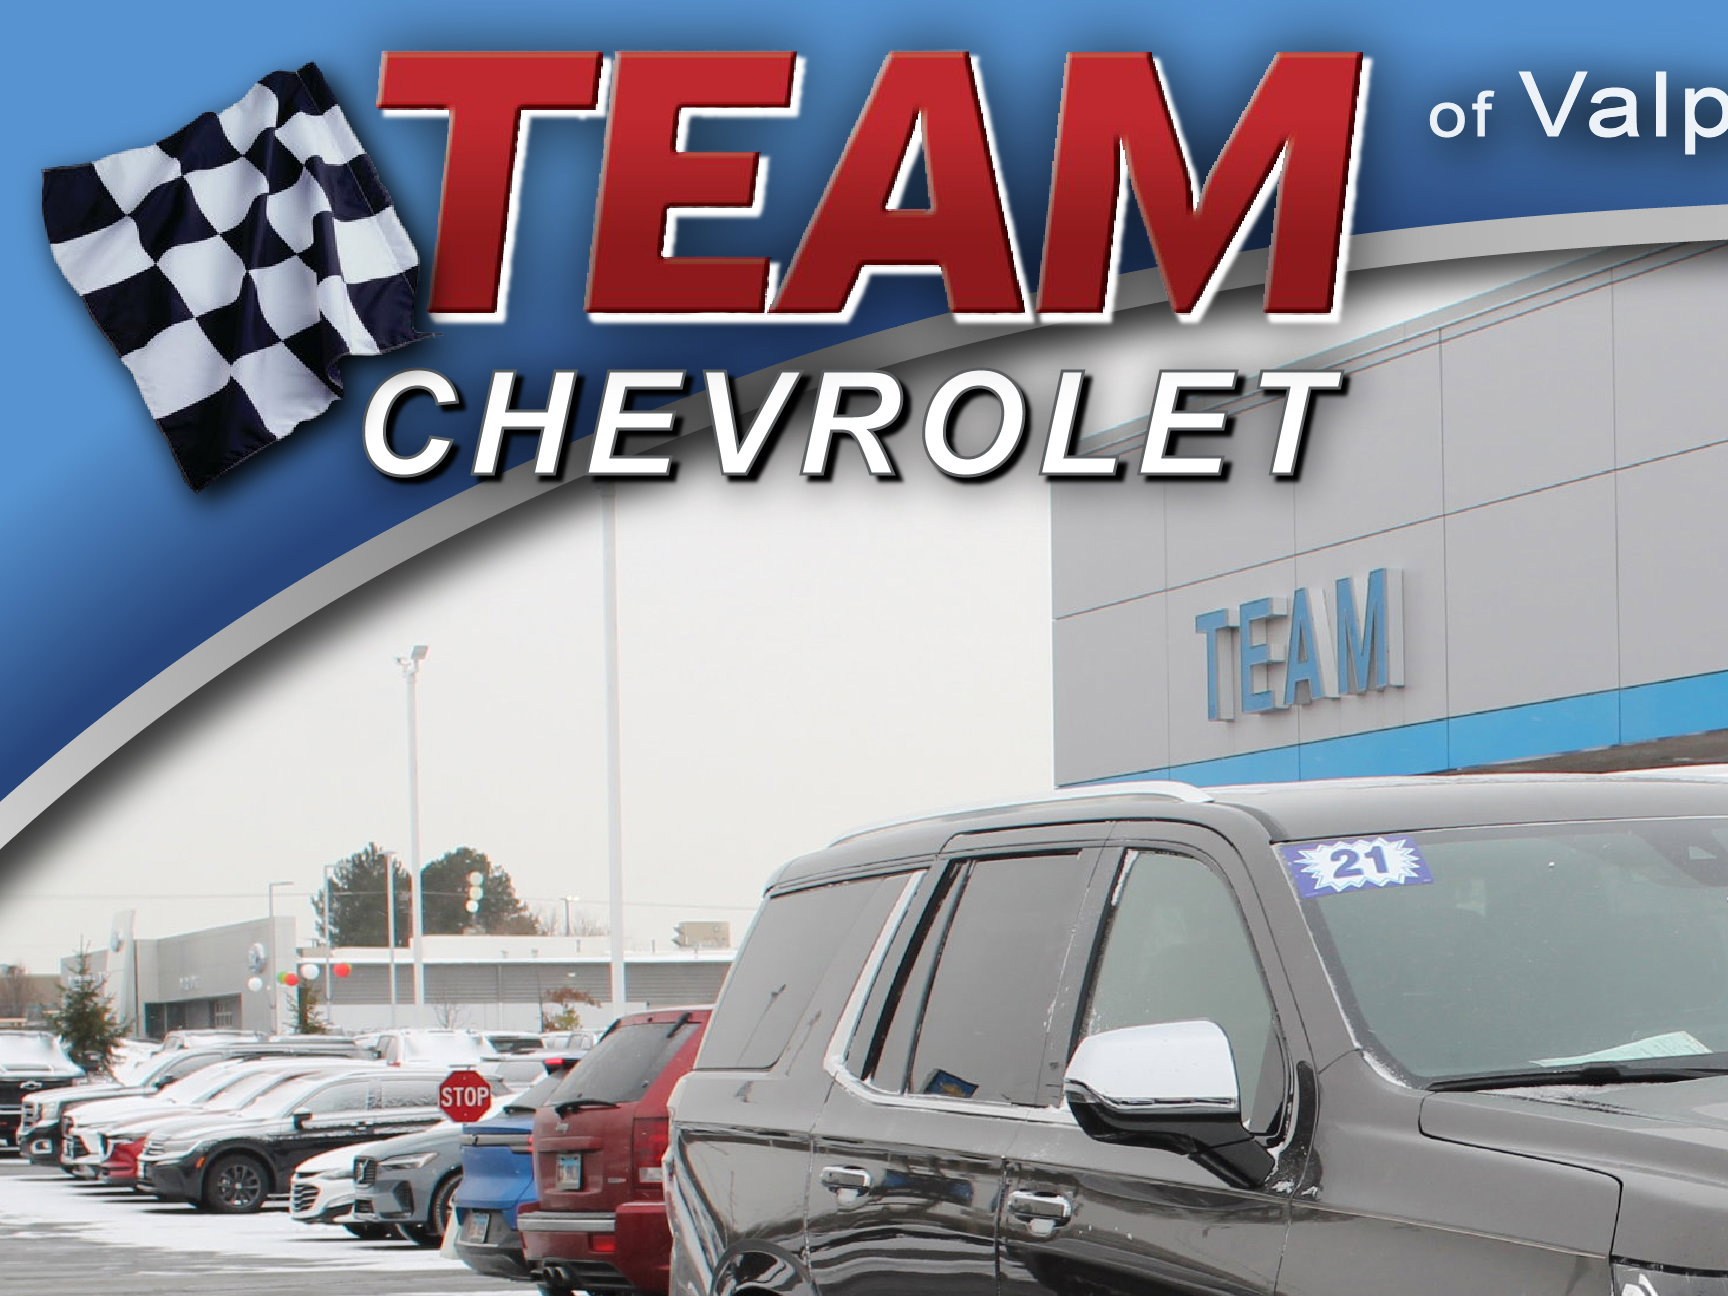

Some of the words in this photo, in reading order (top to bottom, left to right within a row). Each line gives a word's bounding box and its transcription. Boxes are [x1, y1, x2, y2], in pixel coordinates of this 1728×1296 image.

[1195, 567, 1404, 723] TEAM
[1330, 845, 1389, 880] 21
[441, 1086, 489, 1108] STOP
